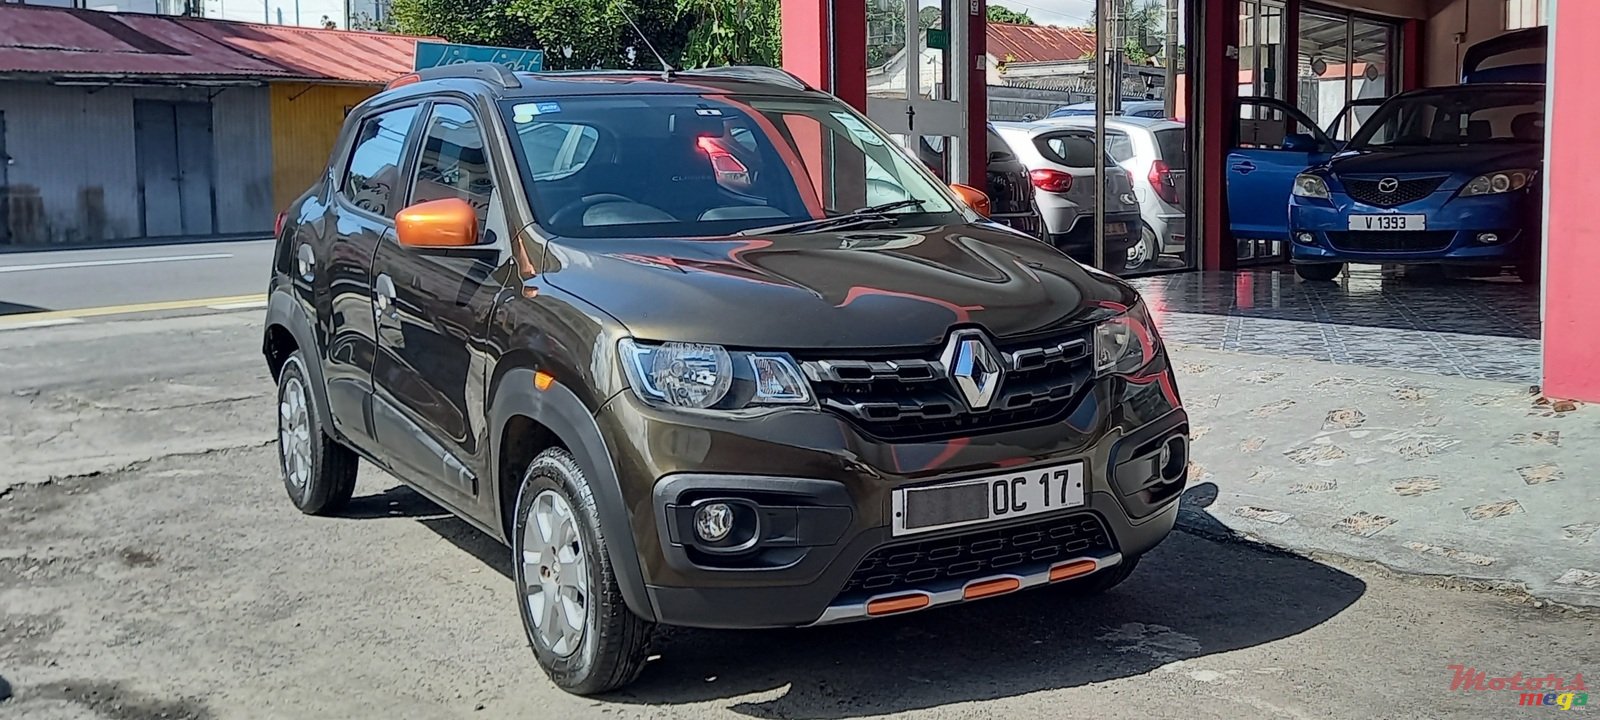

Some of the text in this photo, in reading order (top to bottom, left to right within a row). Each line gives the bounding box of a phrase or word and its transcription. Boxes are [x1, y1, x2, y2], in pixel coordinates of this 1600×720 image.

[1366, 217, 1406, 229] V 1393
[993, 470, 1069, 516] OC 17
